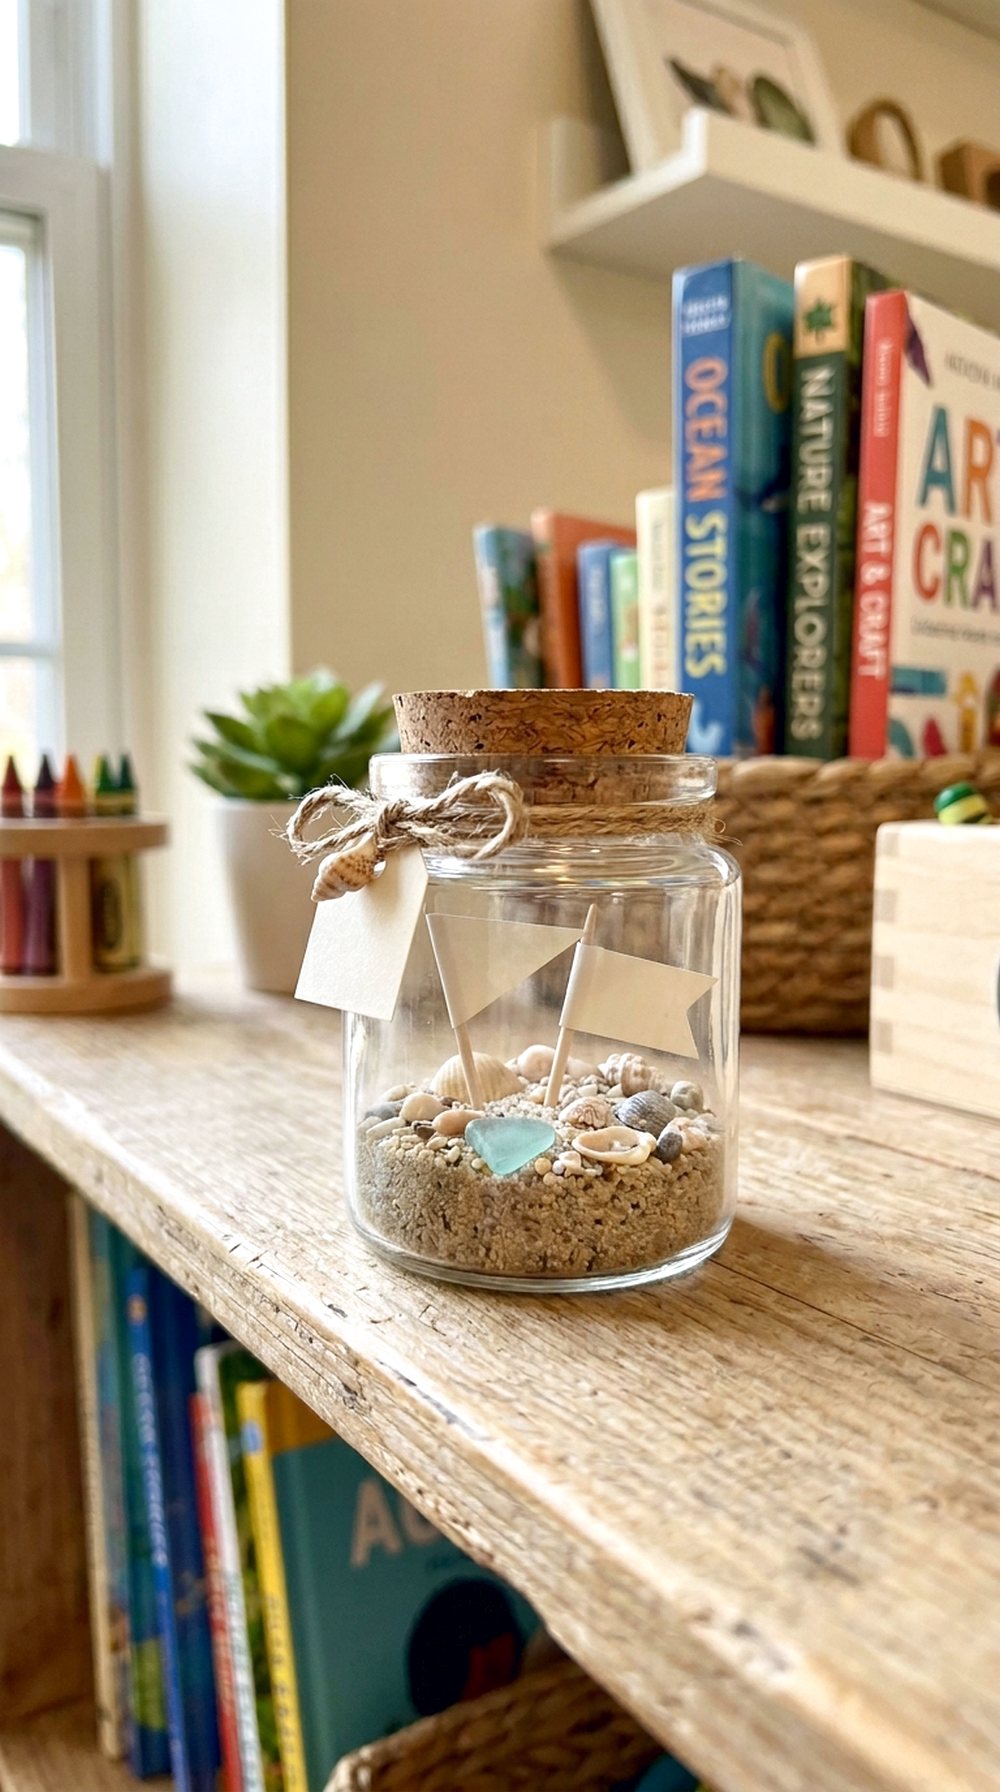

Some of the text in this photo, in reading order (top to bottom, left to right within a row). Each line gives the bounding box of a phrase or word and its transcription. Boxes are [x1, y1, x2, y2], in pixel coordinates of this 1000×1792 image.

[685, 355, 728, 502] OCEAN
[916, 403, 1000, 527] AR
[685, 509, 728, 679] STORIES
[791, 364, 835, 741] NATURE EXPLORERS
[857, 499, 893, 681] ART & CRAFT
